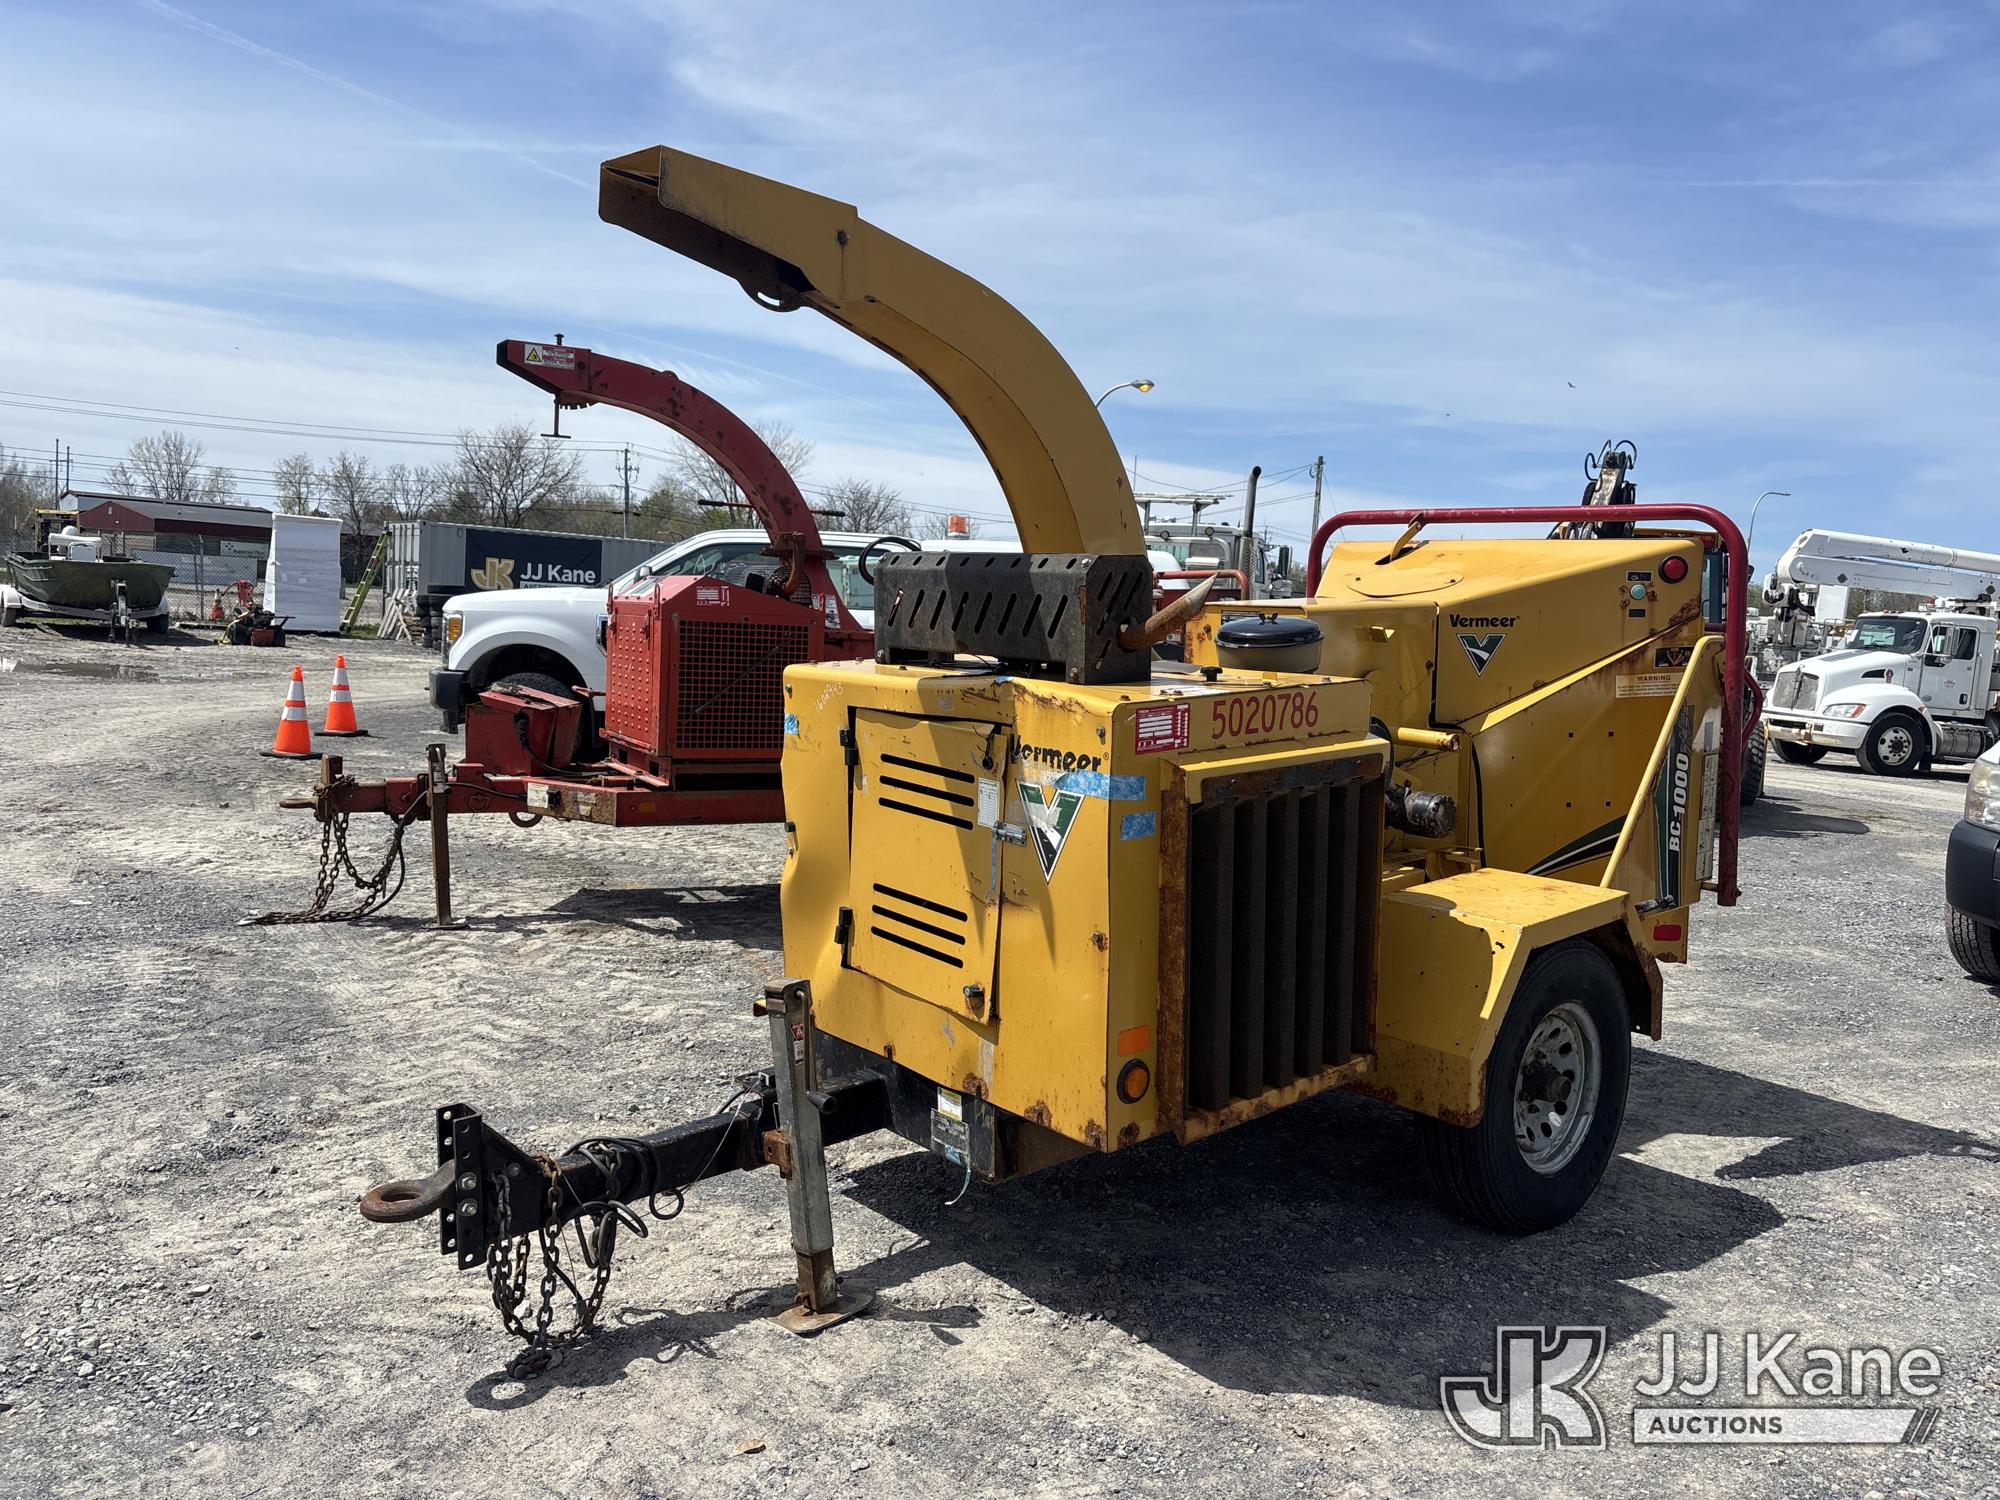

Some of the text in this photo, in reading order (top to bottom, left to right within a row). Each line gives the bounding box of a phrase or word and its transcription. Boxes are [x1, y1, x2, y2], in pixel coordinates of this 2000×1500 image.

[519, 562, 596, 584] JJ Kane
[1449, 614, 1516, 628] Vermeer
[1636, 674, 1671, 682] WARNING
[1211, 690, 1319, 740] 5020786
